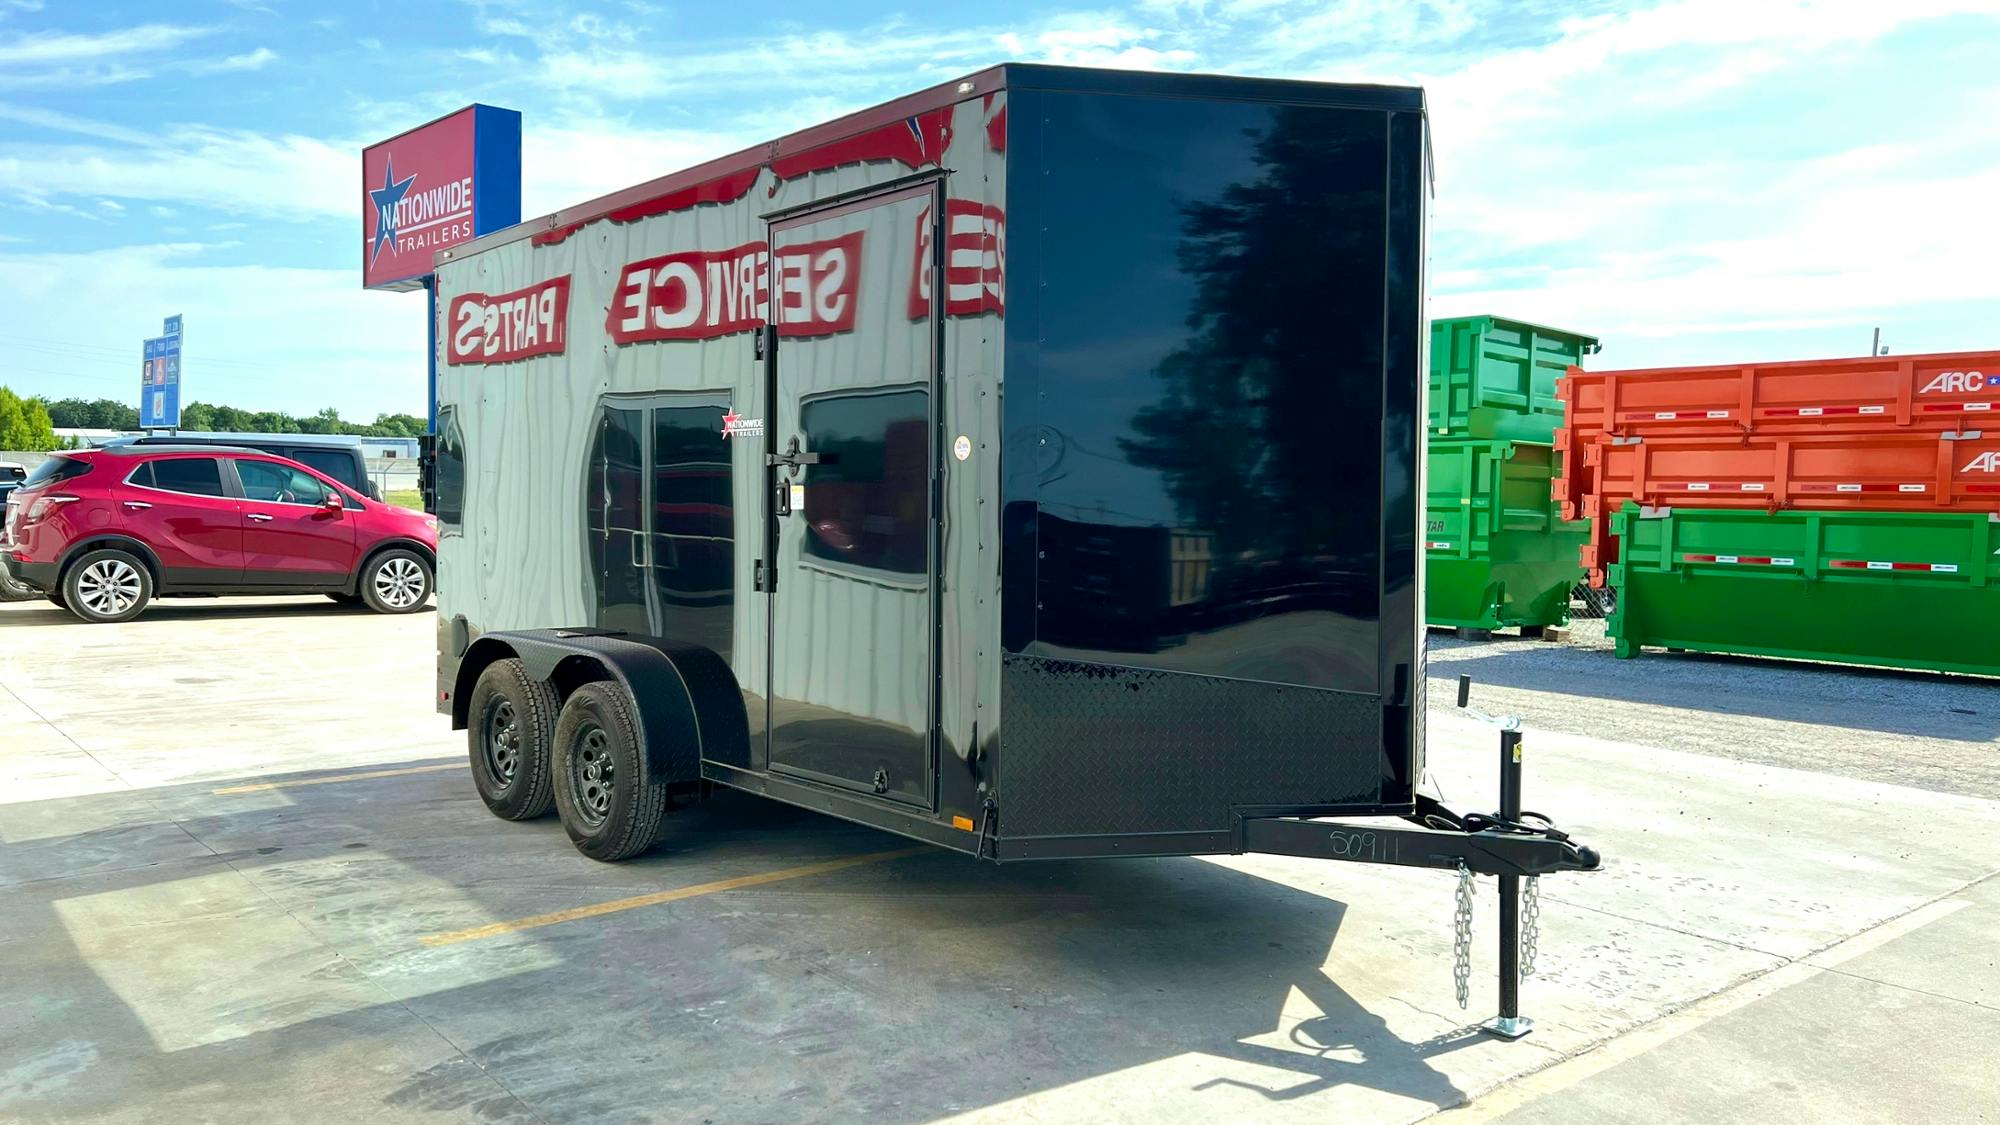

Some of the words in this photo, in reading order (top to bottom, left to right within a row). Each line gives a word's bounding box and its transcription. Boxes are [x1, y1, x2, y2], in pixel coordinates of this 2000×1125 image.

[382, 177, 472, 232] NATIONWIDE
[399, 221, 471, 254] TRAILERS
[1919, 371, 1984, 394] ARC
[727, 418, 764, 429] NATIONWIDE
[1330, 830, 1399, 864] 50911
